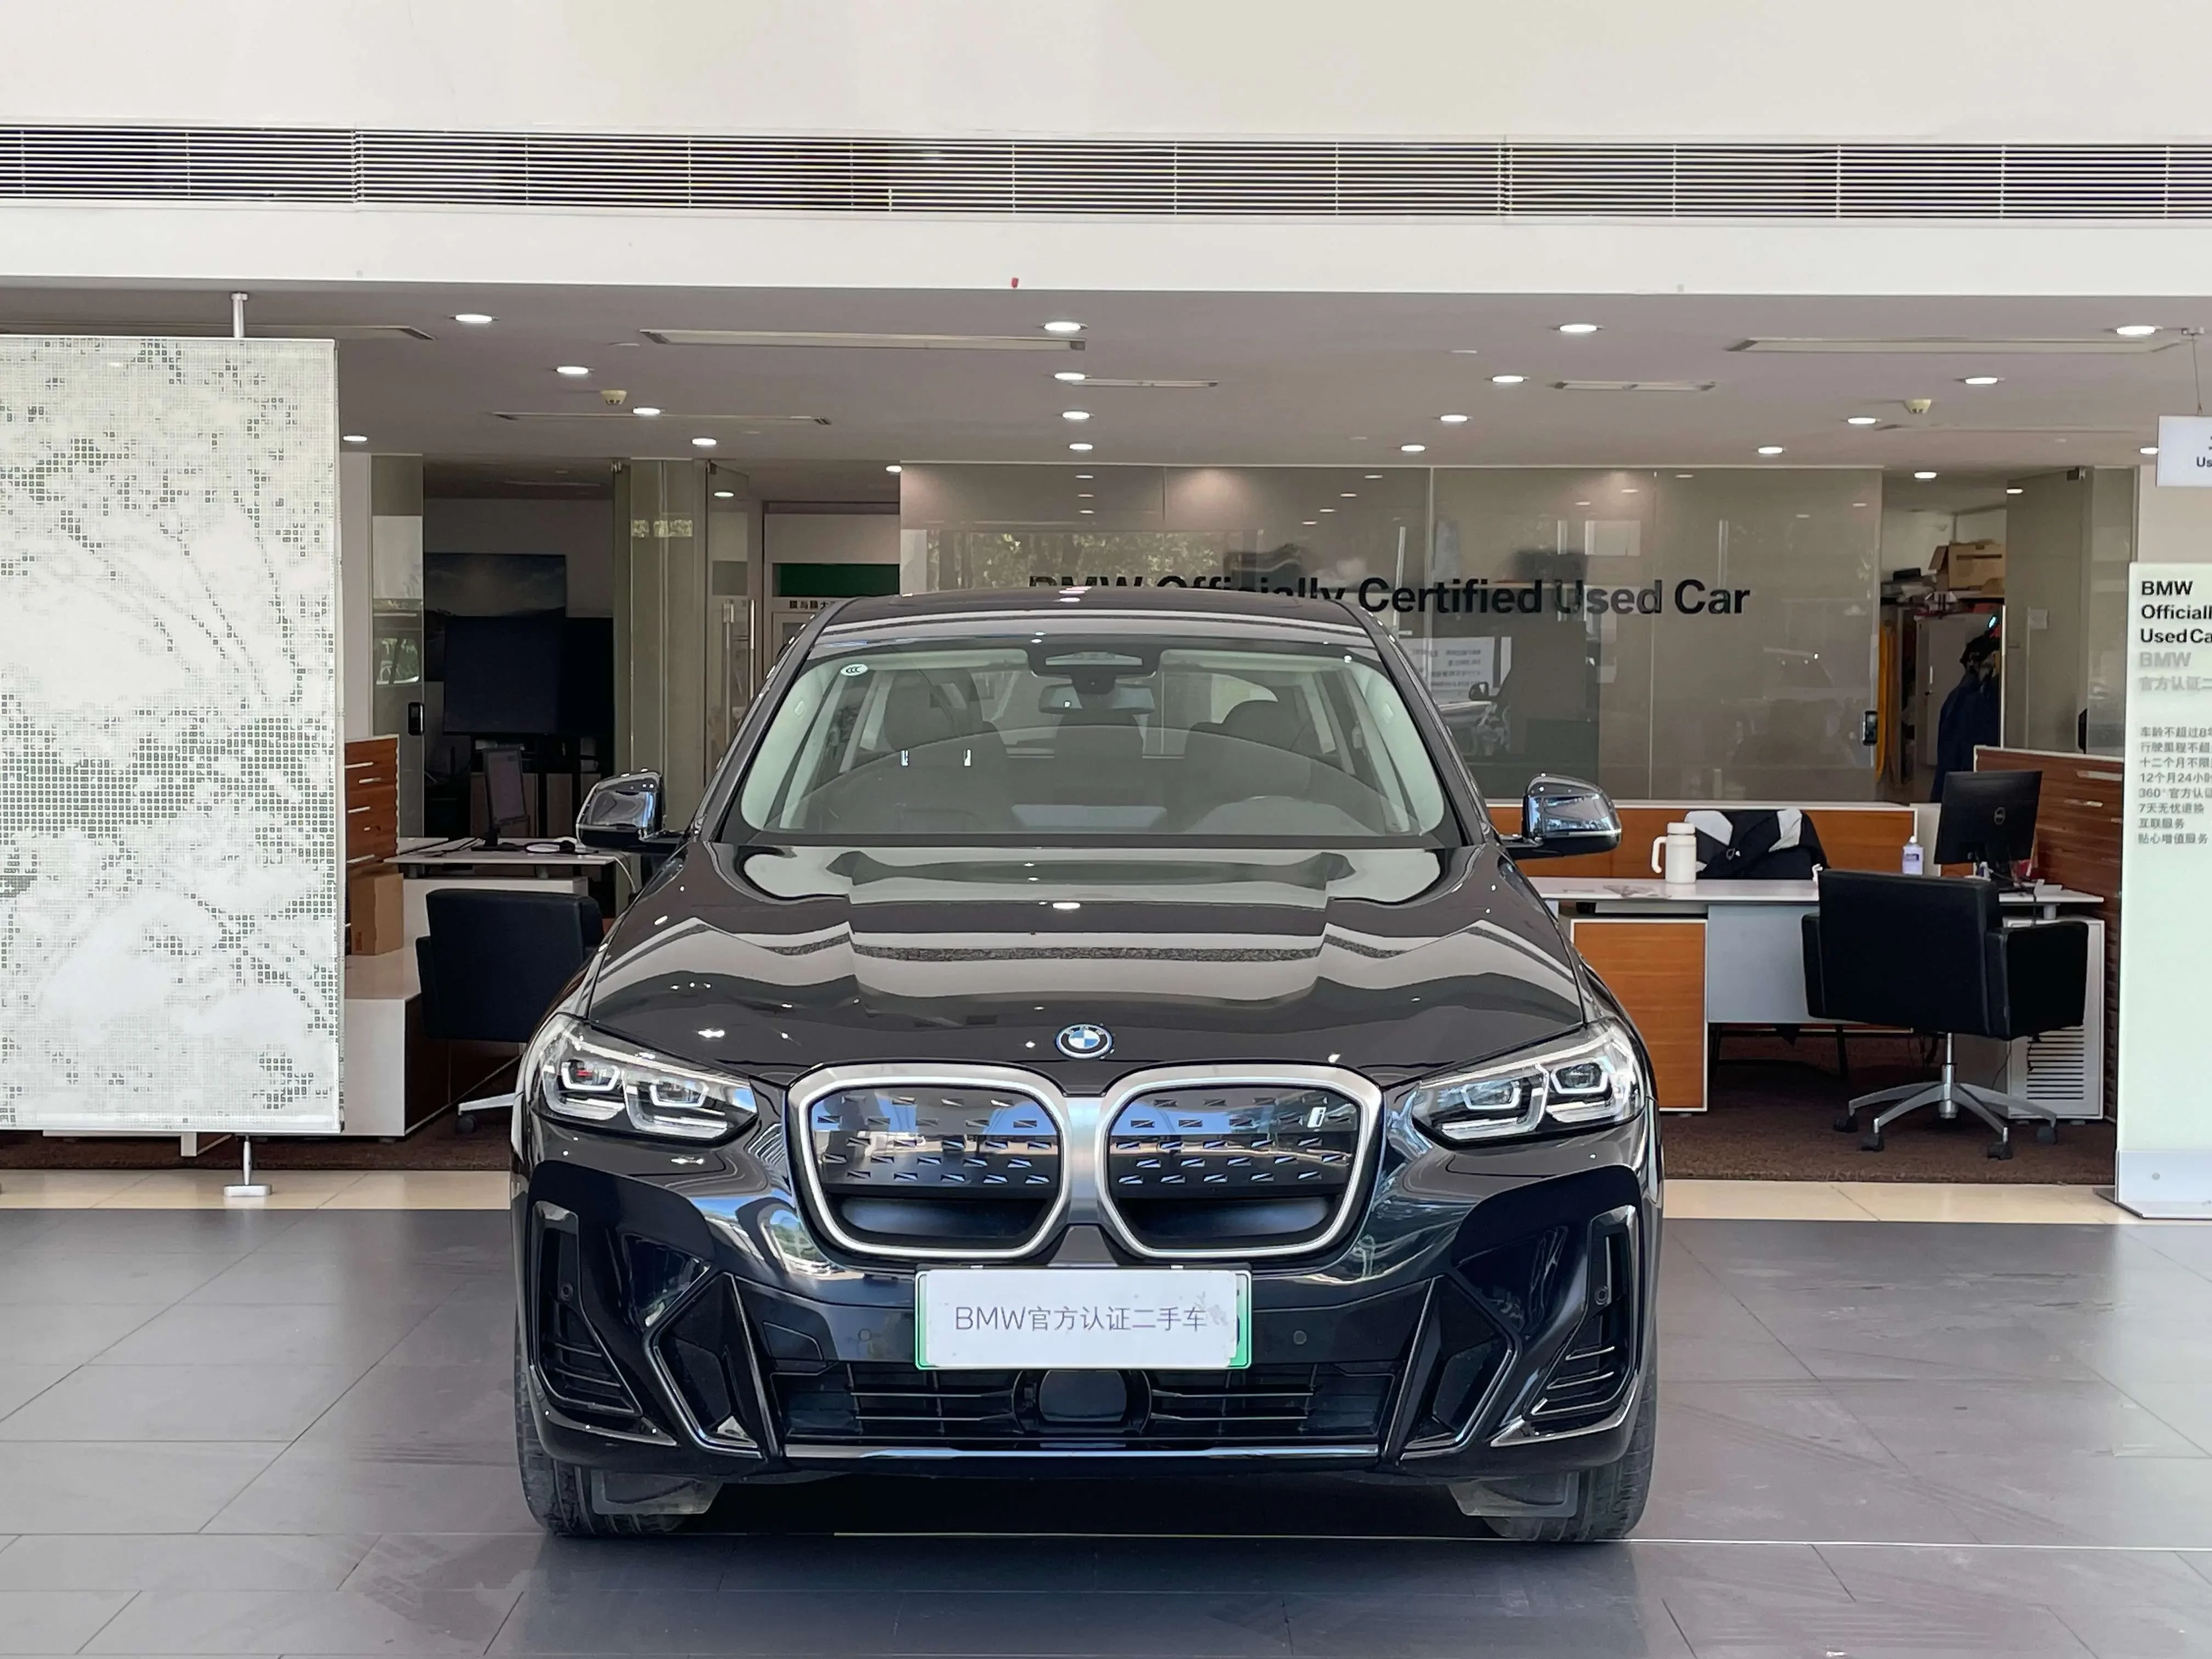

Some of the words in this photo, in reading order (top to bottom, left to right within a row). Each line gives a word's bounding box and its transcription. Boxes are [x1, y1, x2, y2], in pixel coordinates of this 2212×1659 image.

[1358, 578, 1542, 614] Certified
[1555, 579, 1663, 615] Used
[1675, 578, 1750, 615] Car
[2141, 580, 2193, 596] BMW
[2140, 628, 2187, 643] Used
[2139, 651, 2191, 668] BMW
[955, 1305, 1209, 1332] BMW官方认证二手车
